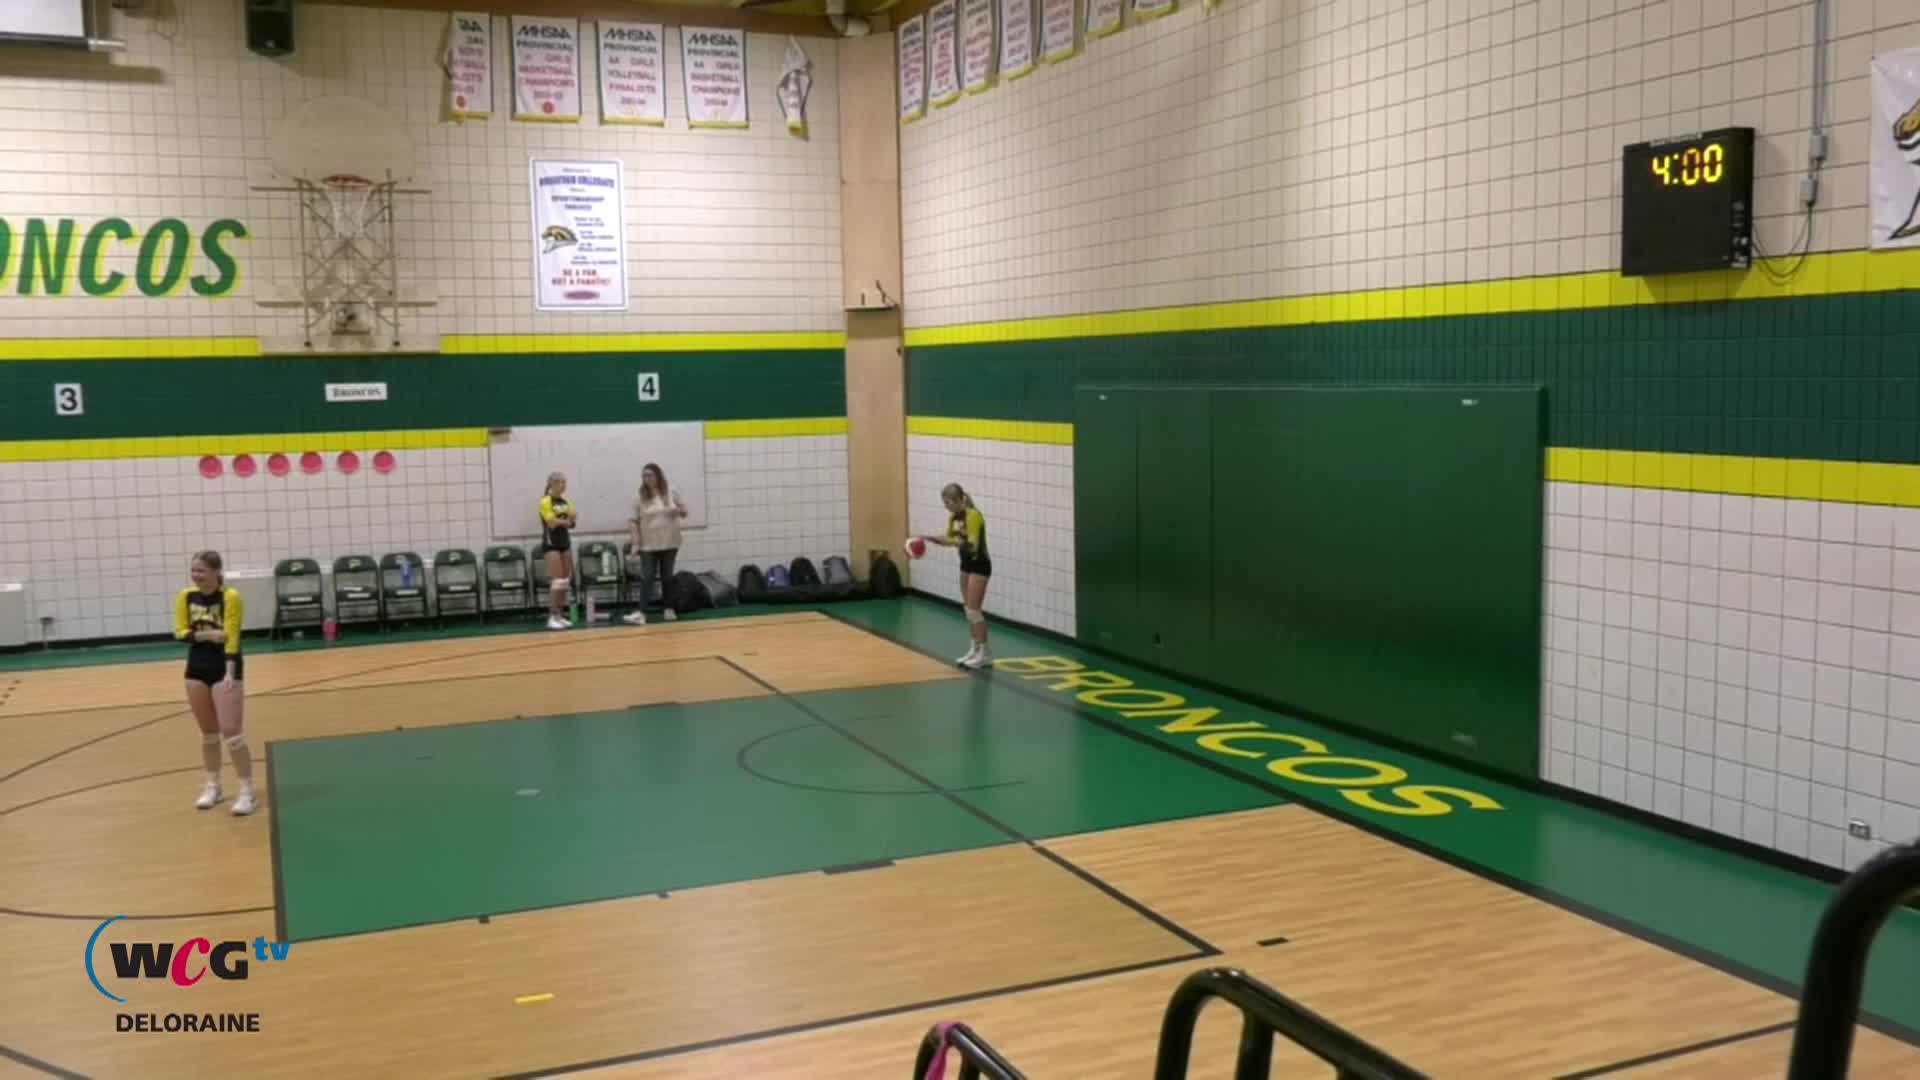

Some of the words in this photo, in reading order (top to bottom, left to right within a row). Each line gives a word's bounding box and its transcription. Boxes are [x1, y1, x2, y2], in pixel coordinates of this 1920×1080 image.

[1652, 144, 1723, 185] 4:00
[0, 217, 251, 298] NCOS
[60, 387, 78, 411] 3
[642, 376, 656, 397] 4
[992, 656, 1505, 817] BRONCOS
